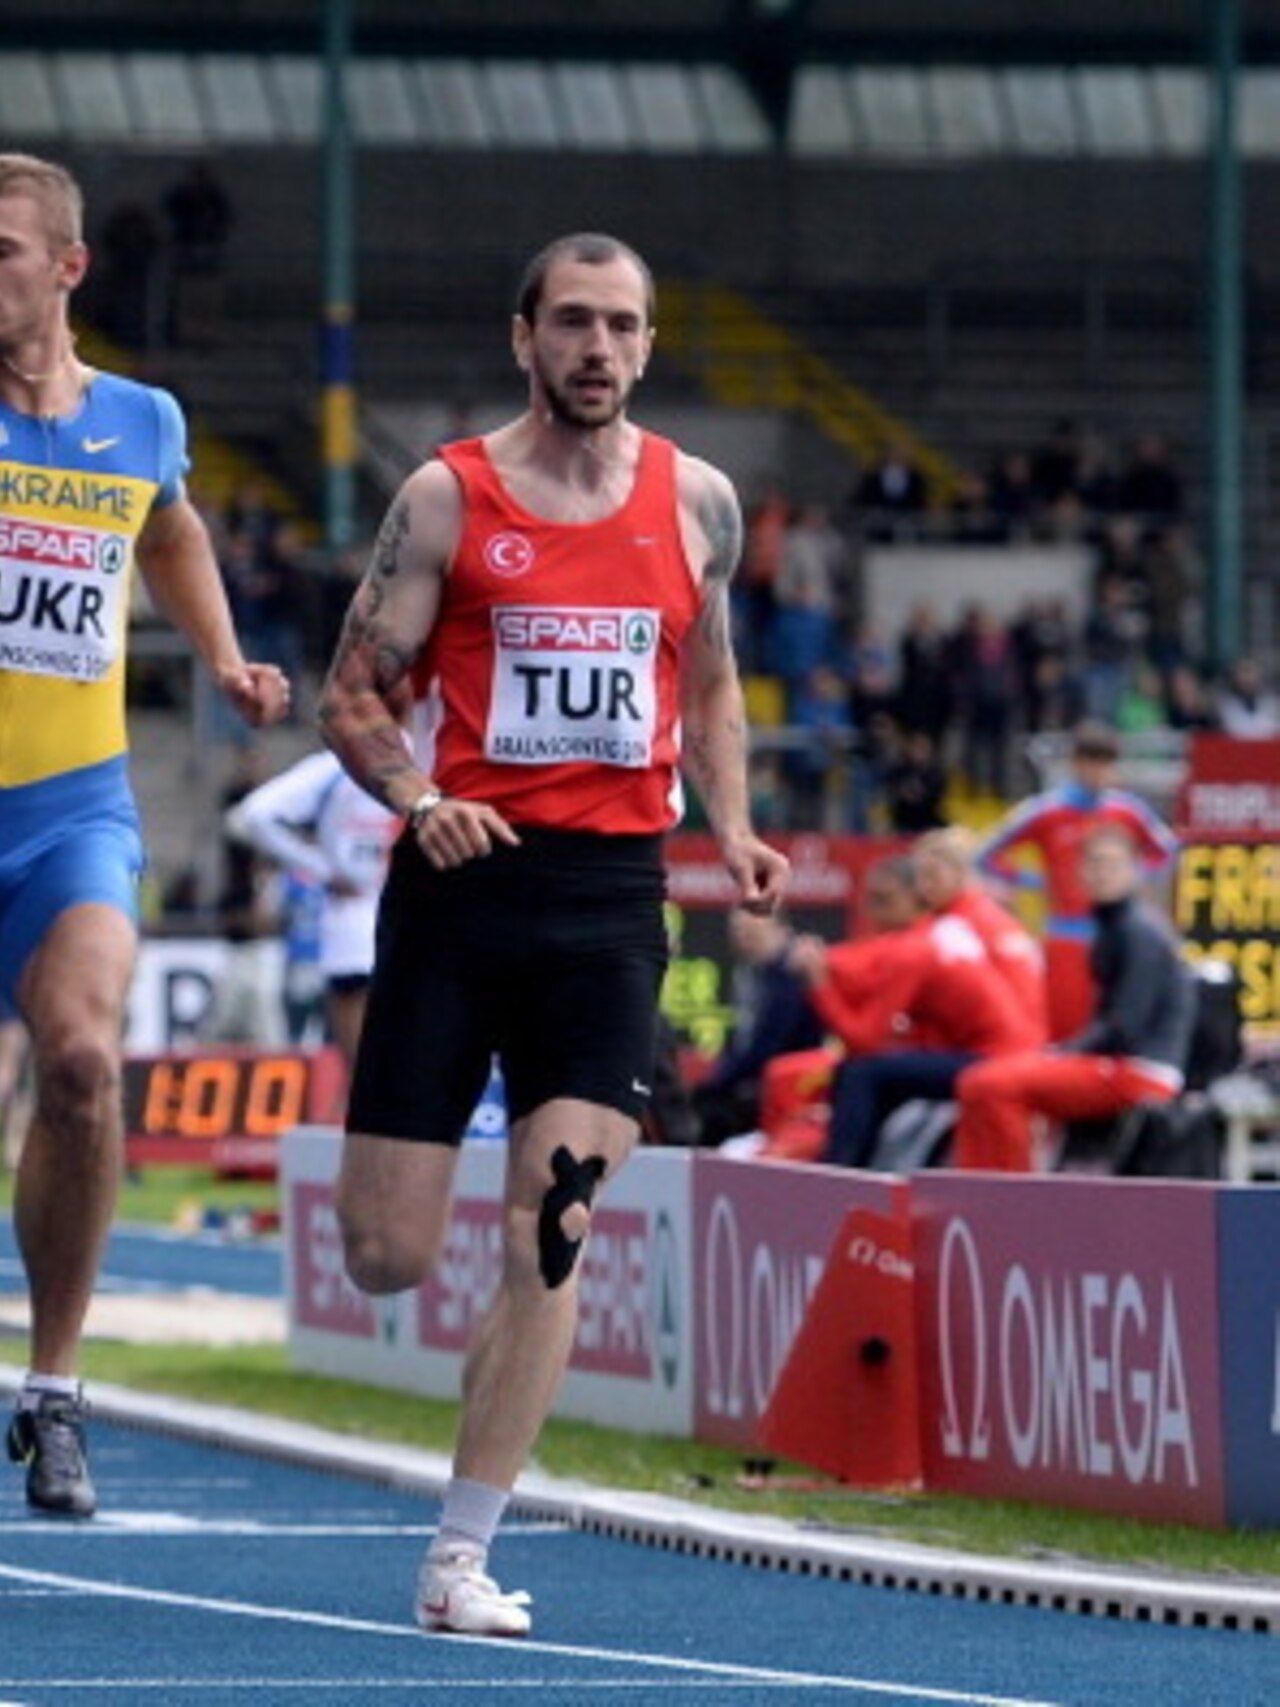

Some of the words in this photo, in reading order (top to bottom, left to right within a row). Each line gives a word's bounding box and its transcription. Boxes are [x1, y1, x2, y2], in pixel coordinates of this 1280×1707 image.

[497, 615, 618, 648] SPAR
[512, 663, 642, 722] TUR
[998, 1262, 1199, 1489] OMEGA
